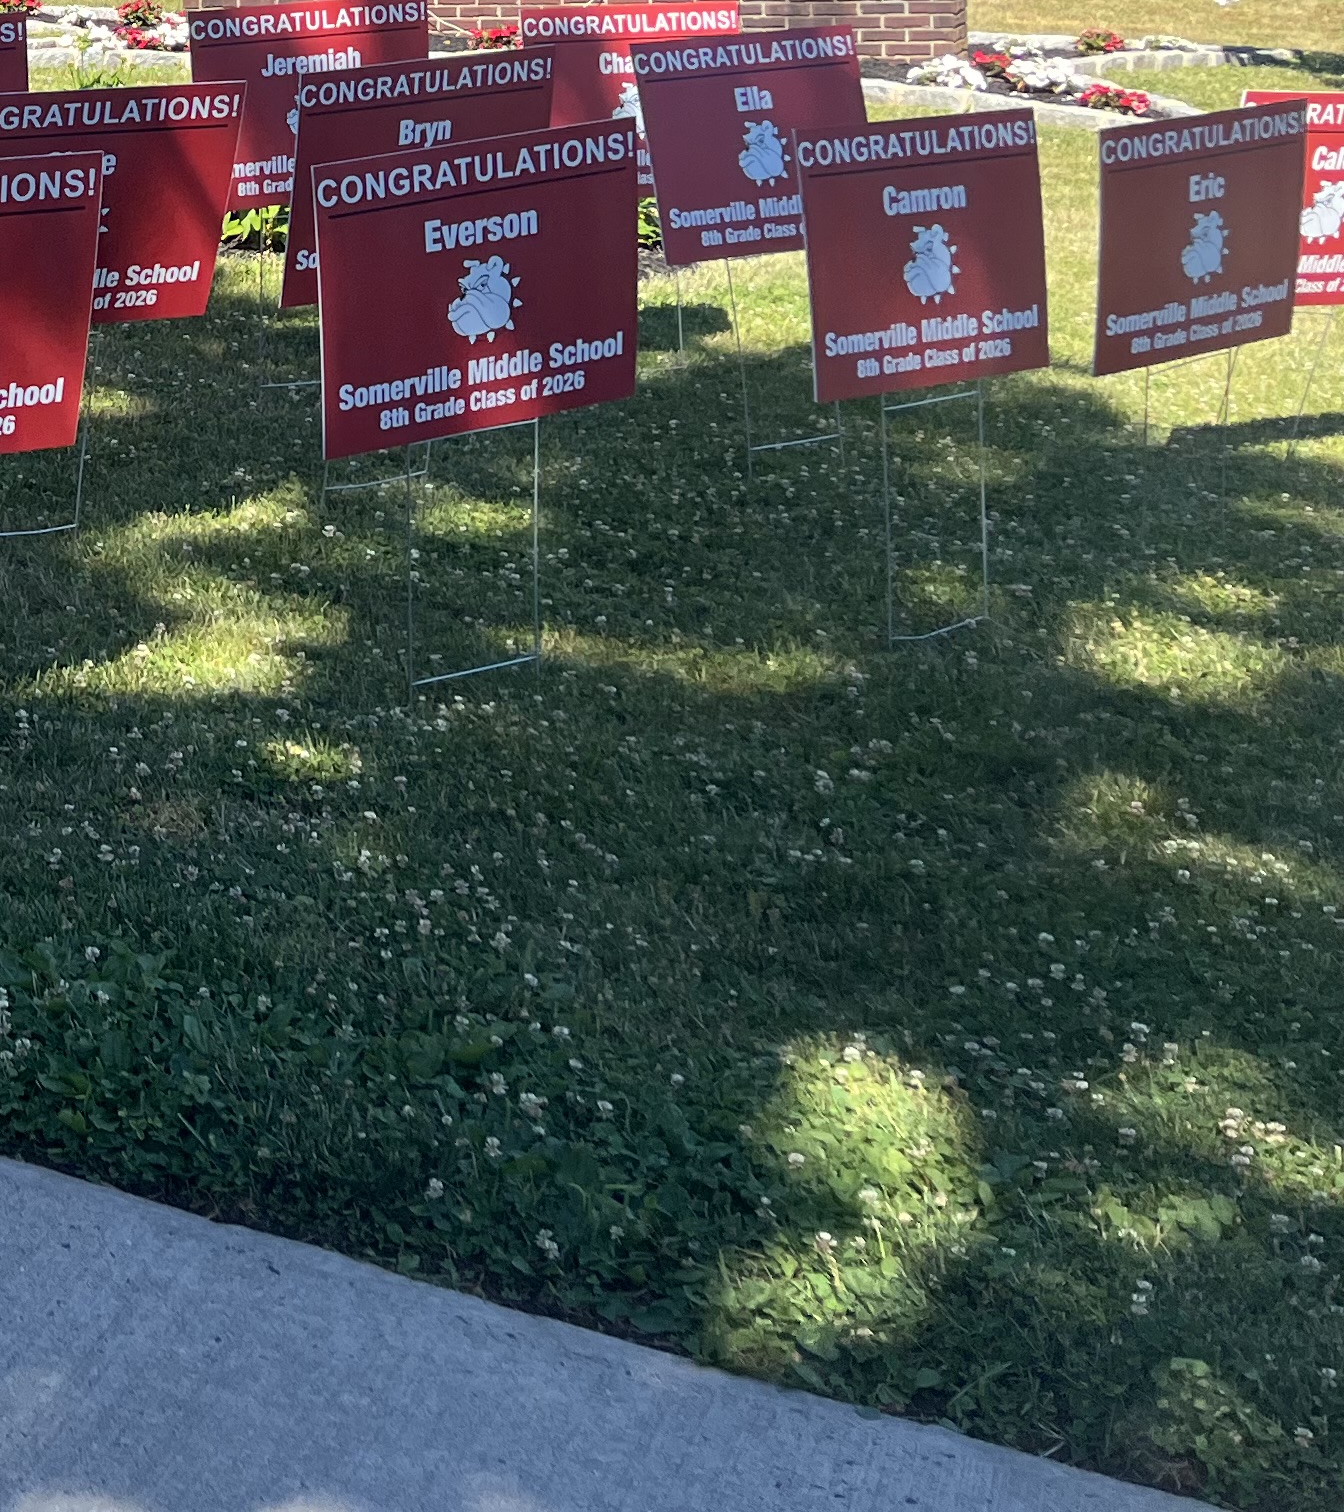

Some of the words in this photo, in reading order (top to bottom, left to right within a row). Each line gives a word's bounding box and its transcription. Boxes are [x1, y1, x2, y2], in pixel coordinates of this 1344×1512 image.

[191, 2, 425, 40] CONGRATULATIONS!
[524, 10, 737, 36] CONGRATULATIONS!
[261, 47, 361, 78] Jeremiah
[633, 35, 854, 74] CONGRATULATIONS!
[301, 58, 551, 107] CONGRATULATIONS!
[734, 86, 773, 111] Ella
[397, 120, 453, 150] Bryn
[798, 121, 1035, 165] CONGRATULATIONS!
[1101, 109, 1303, 163] CONGRATULATIONS!
[317, 131, 633, 207] CONGRATULATIONS!
[1189, 173, 1225, 202] Eric
[238, 181, 259, 196] 8th
[883, 185, 966, 216] Camron
[425, 210, 537, 253] Everson
[669, 203, 756, 228] Somerville
[701, 230, 722, 246] 8th
[725, 226, 761, 243] Grade
[764, 223, 797, 238] Class
[125, 261, 200, 285] School
[114, 290, 157, 307] 2026
[1106, 306, 1187, 336] Somerville
[1190, 291, 1238, 319] Middle
[1241, 279, 1288, 307] School
[825, 323, 917, 356] Somerville
[921, 314, 978, 342] Middle
[982, 304, 1038, 334] School
[1131, 336, 1151, 354] 8th
[1234, 311, 1262, 331] 2026
[339, 366, 463, 413] Somerville
[468, 351, 542, 385] Middle
[549, 331, 623, 368] School
[857, 358, 880, 378] 8th
[883, 352, 921, 374] Grade
[924, 349, 959, 368] Class
[962, 343, 976, 362] of
[978, 338, 1011, 359] 2026
[380, 407, 409, 430] 8th
[415, 397, 465, 423] Grade
[470, 388, 515, 411] Class
[521, 379, 538, 400] of
[542, 371, 584, 396] 2026
